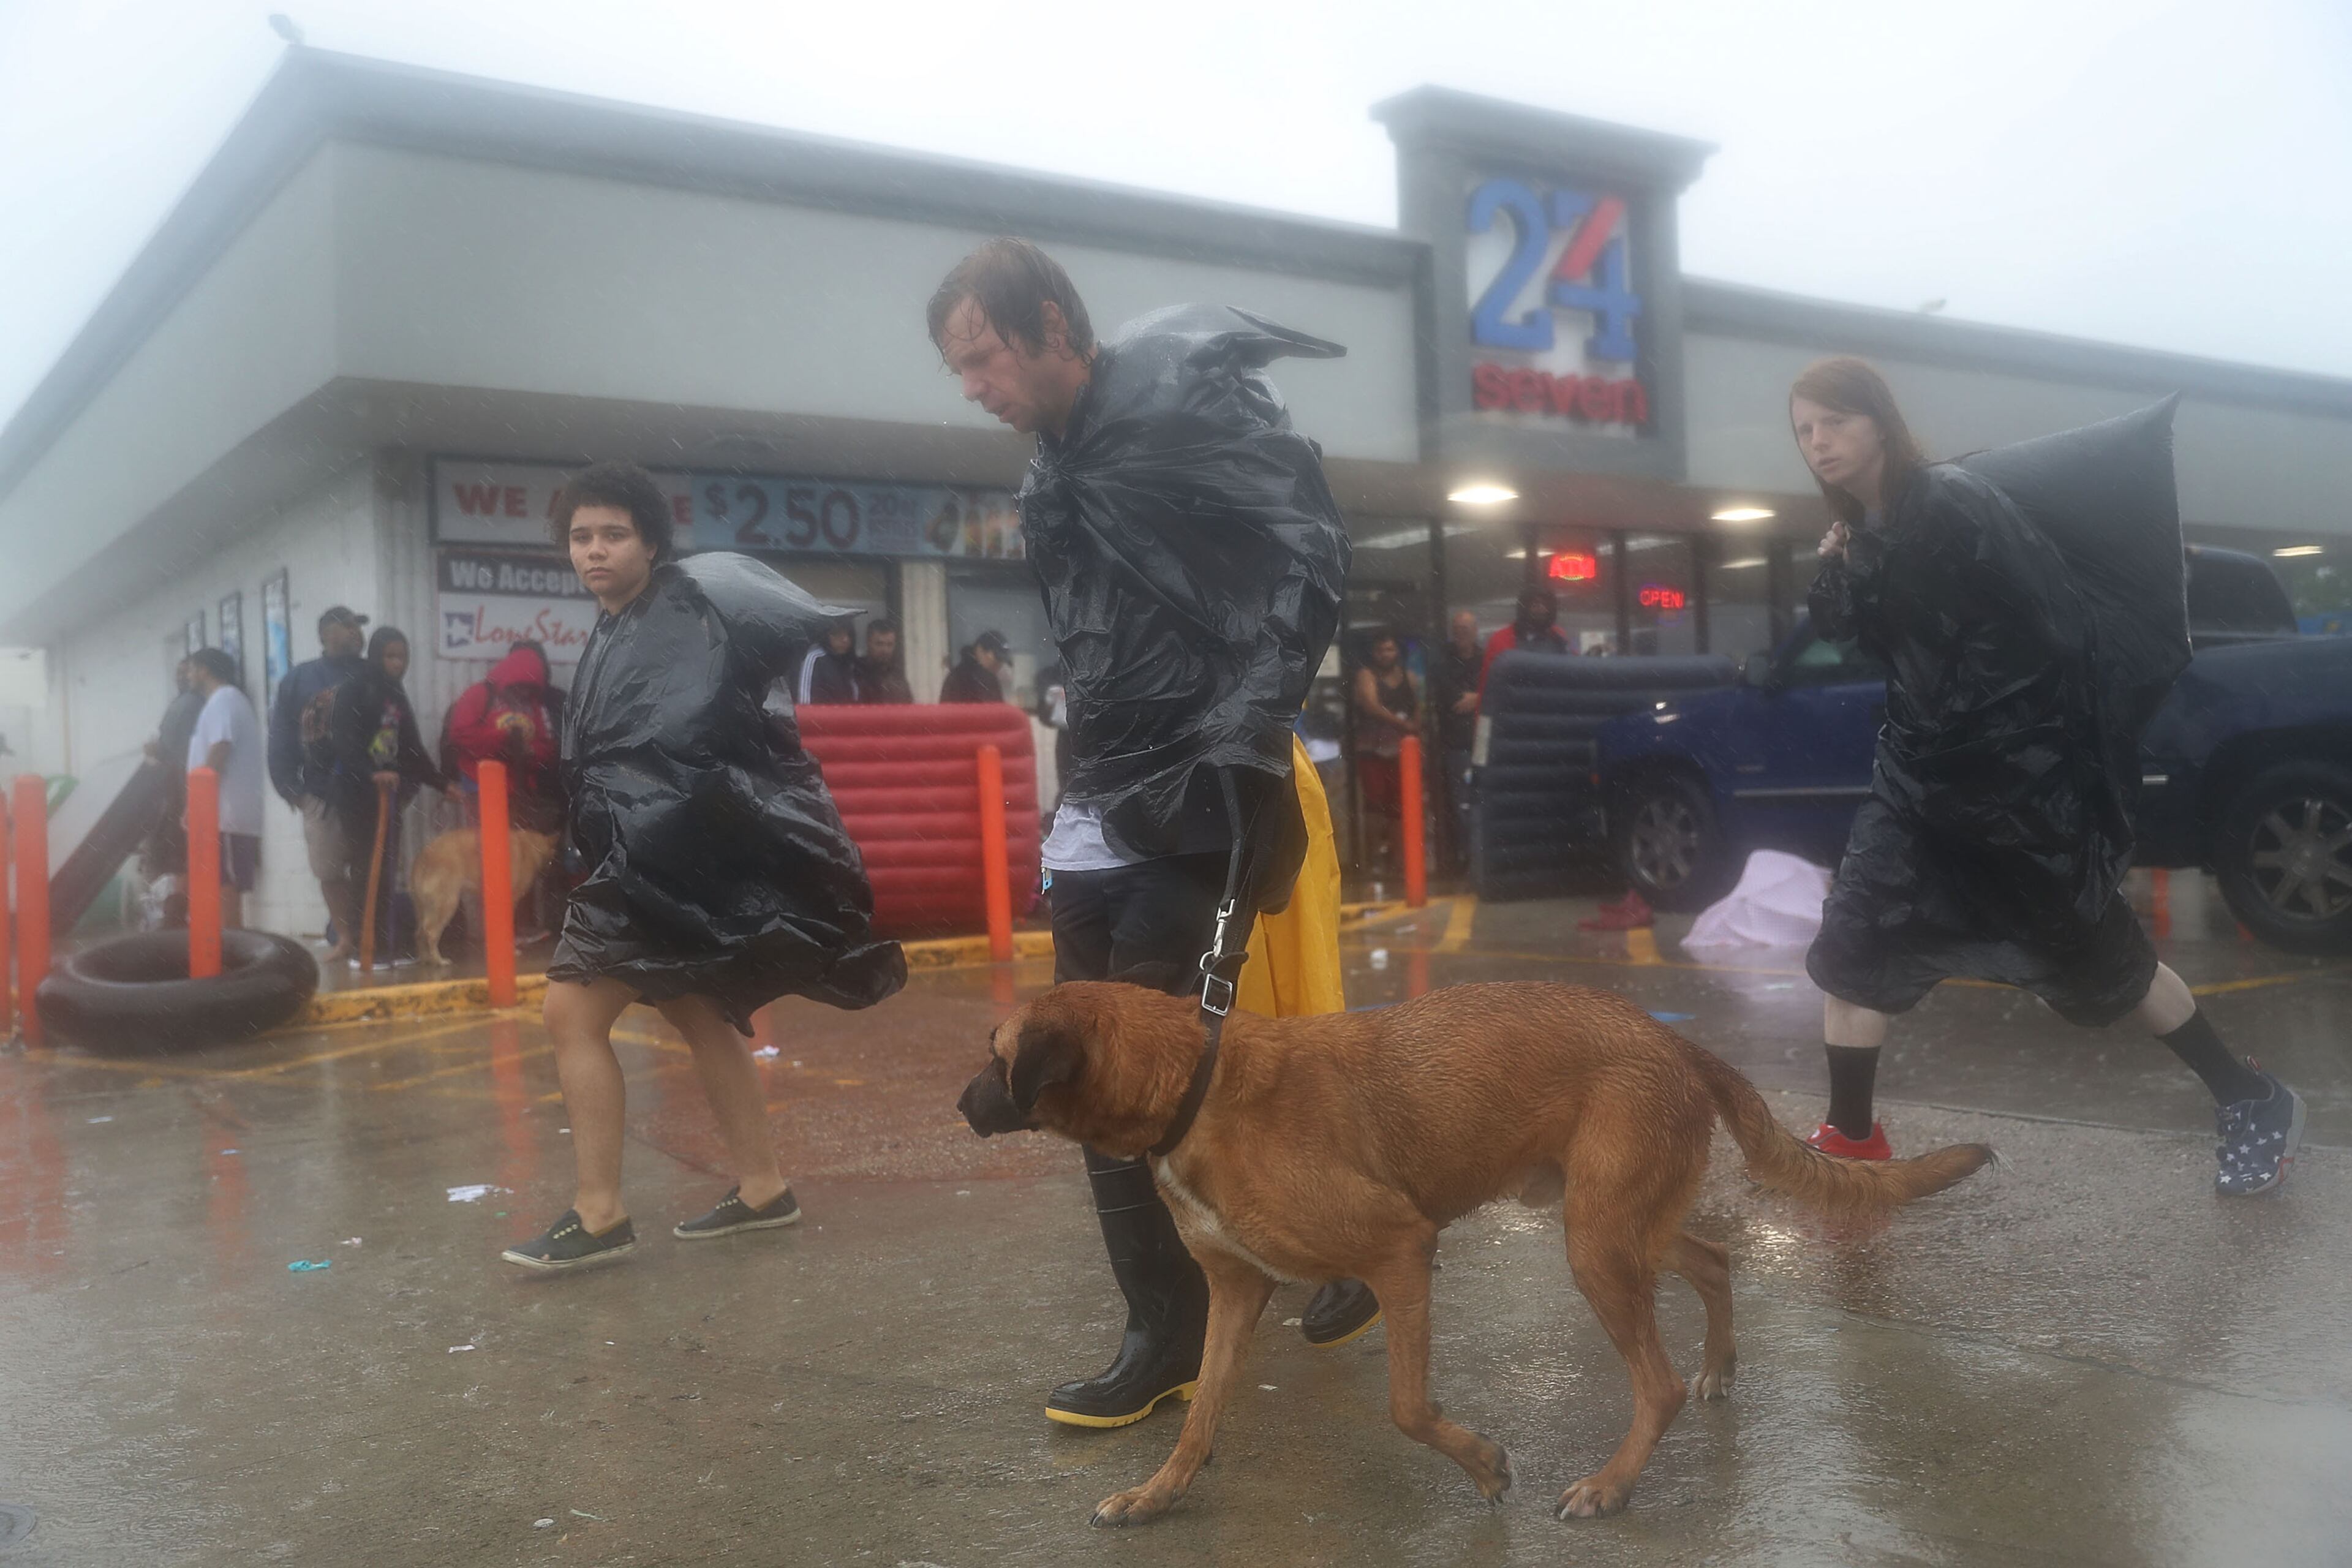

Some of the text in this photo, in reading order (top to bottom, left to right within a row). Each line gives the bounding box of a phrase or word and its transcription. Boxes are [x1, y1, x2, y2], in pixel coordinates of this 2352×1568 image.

[453, 484, 527, 518] WE
[450, 560, 493, 588] We
[1640, 589, 1684, 608] OPEN
